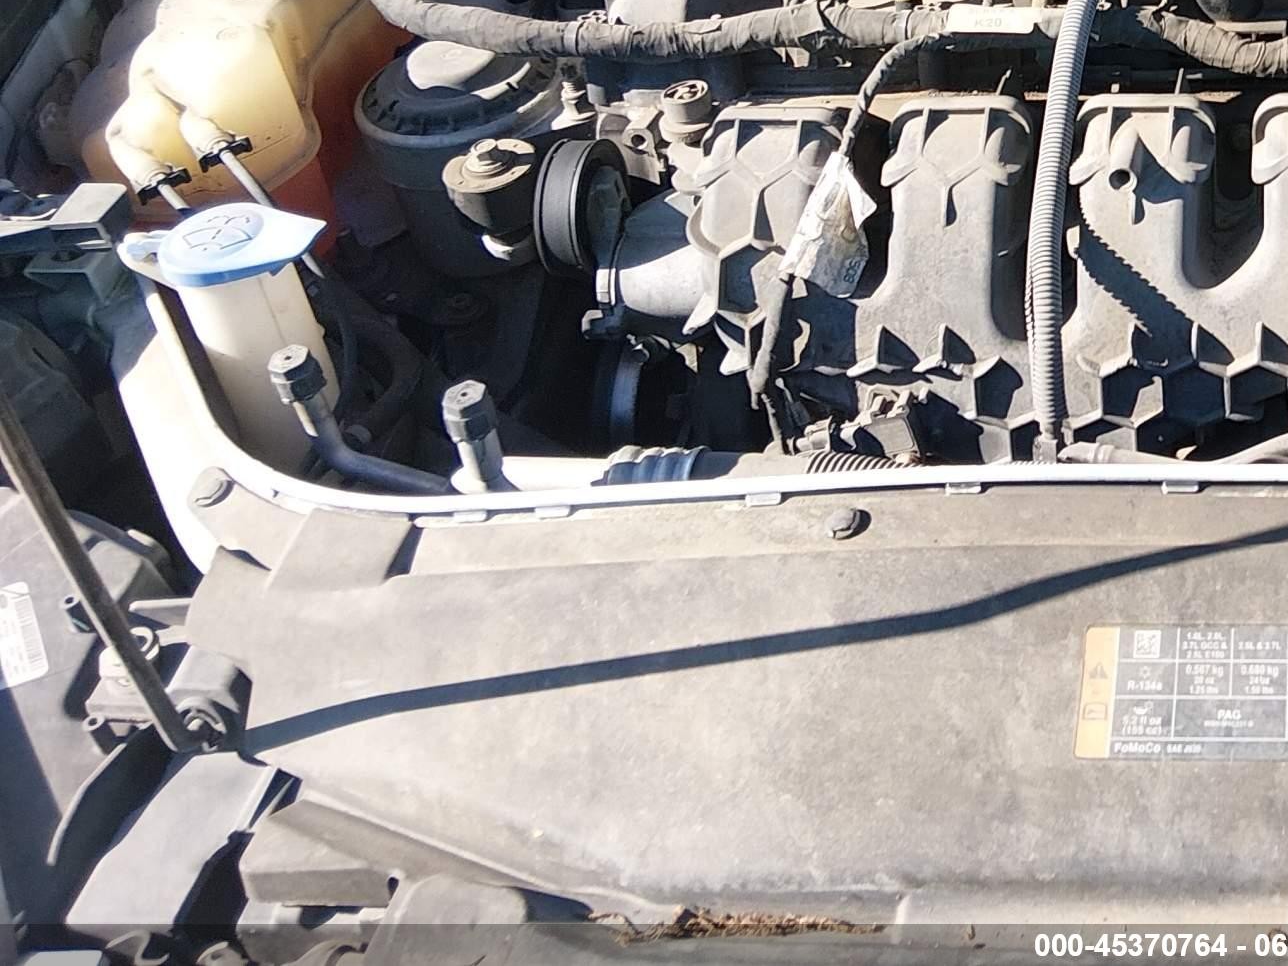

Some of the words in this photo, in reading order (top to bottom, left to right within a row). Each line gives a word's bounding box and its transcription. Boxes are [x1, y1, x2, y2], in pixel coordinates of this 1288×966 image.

[1210, 664, 1224, 678] kg
[1266, 664, 1280, 678] kg
[1126, 680, 1163, 691] R-134a
[1216, 709, 1242, 720] PAG
[1148, 716, 1162, 726] oz
[1113, 742, 1161, 754] FoMoCo
